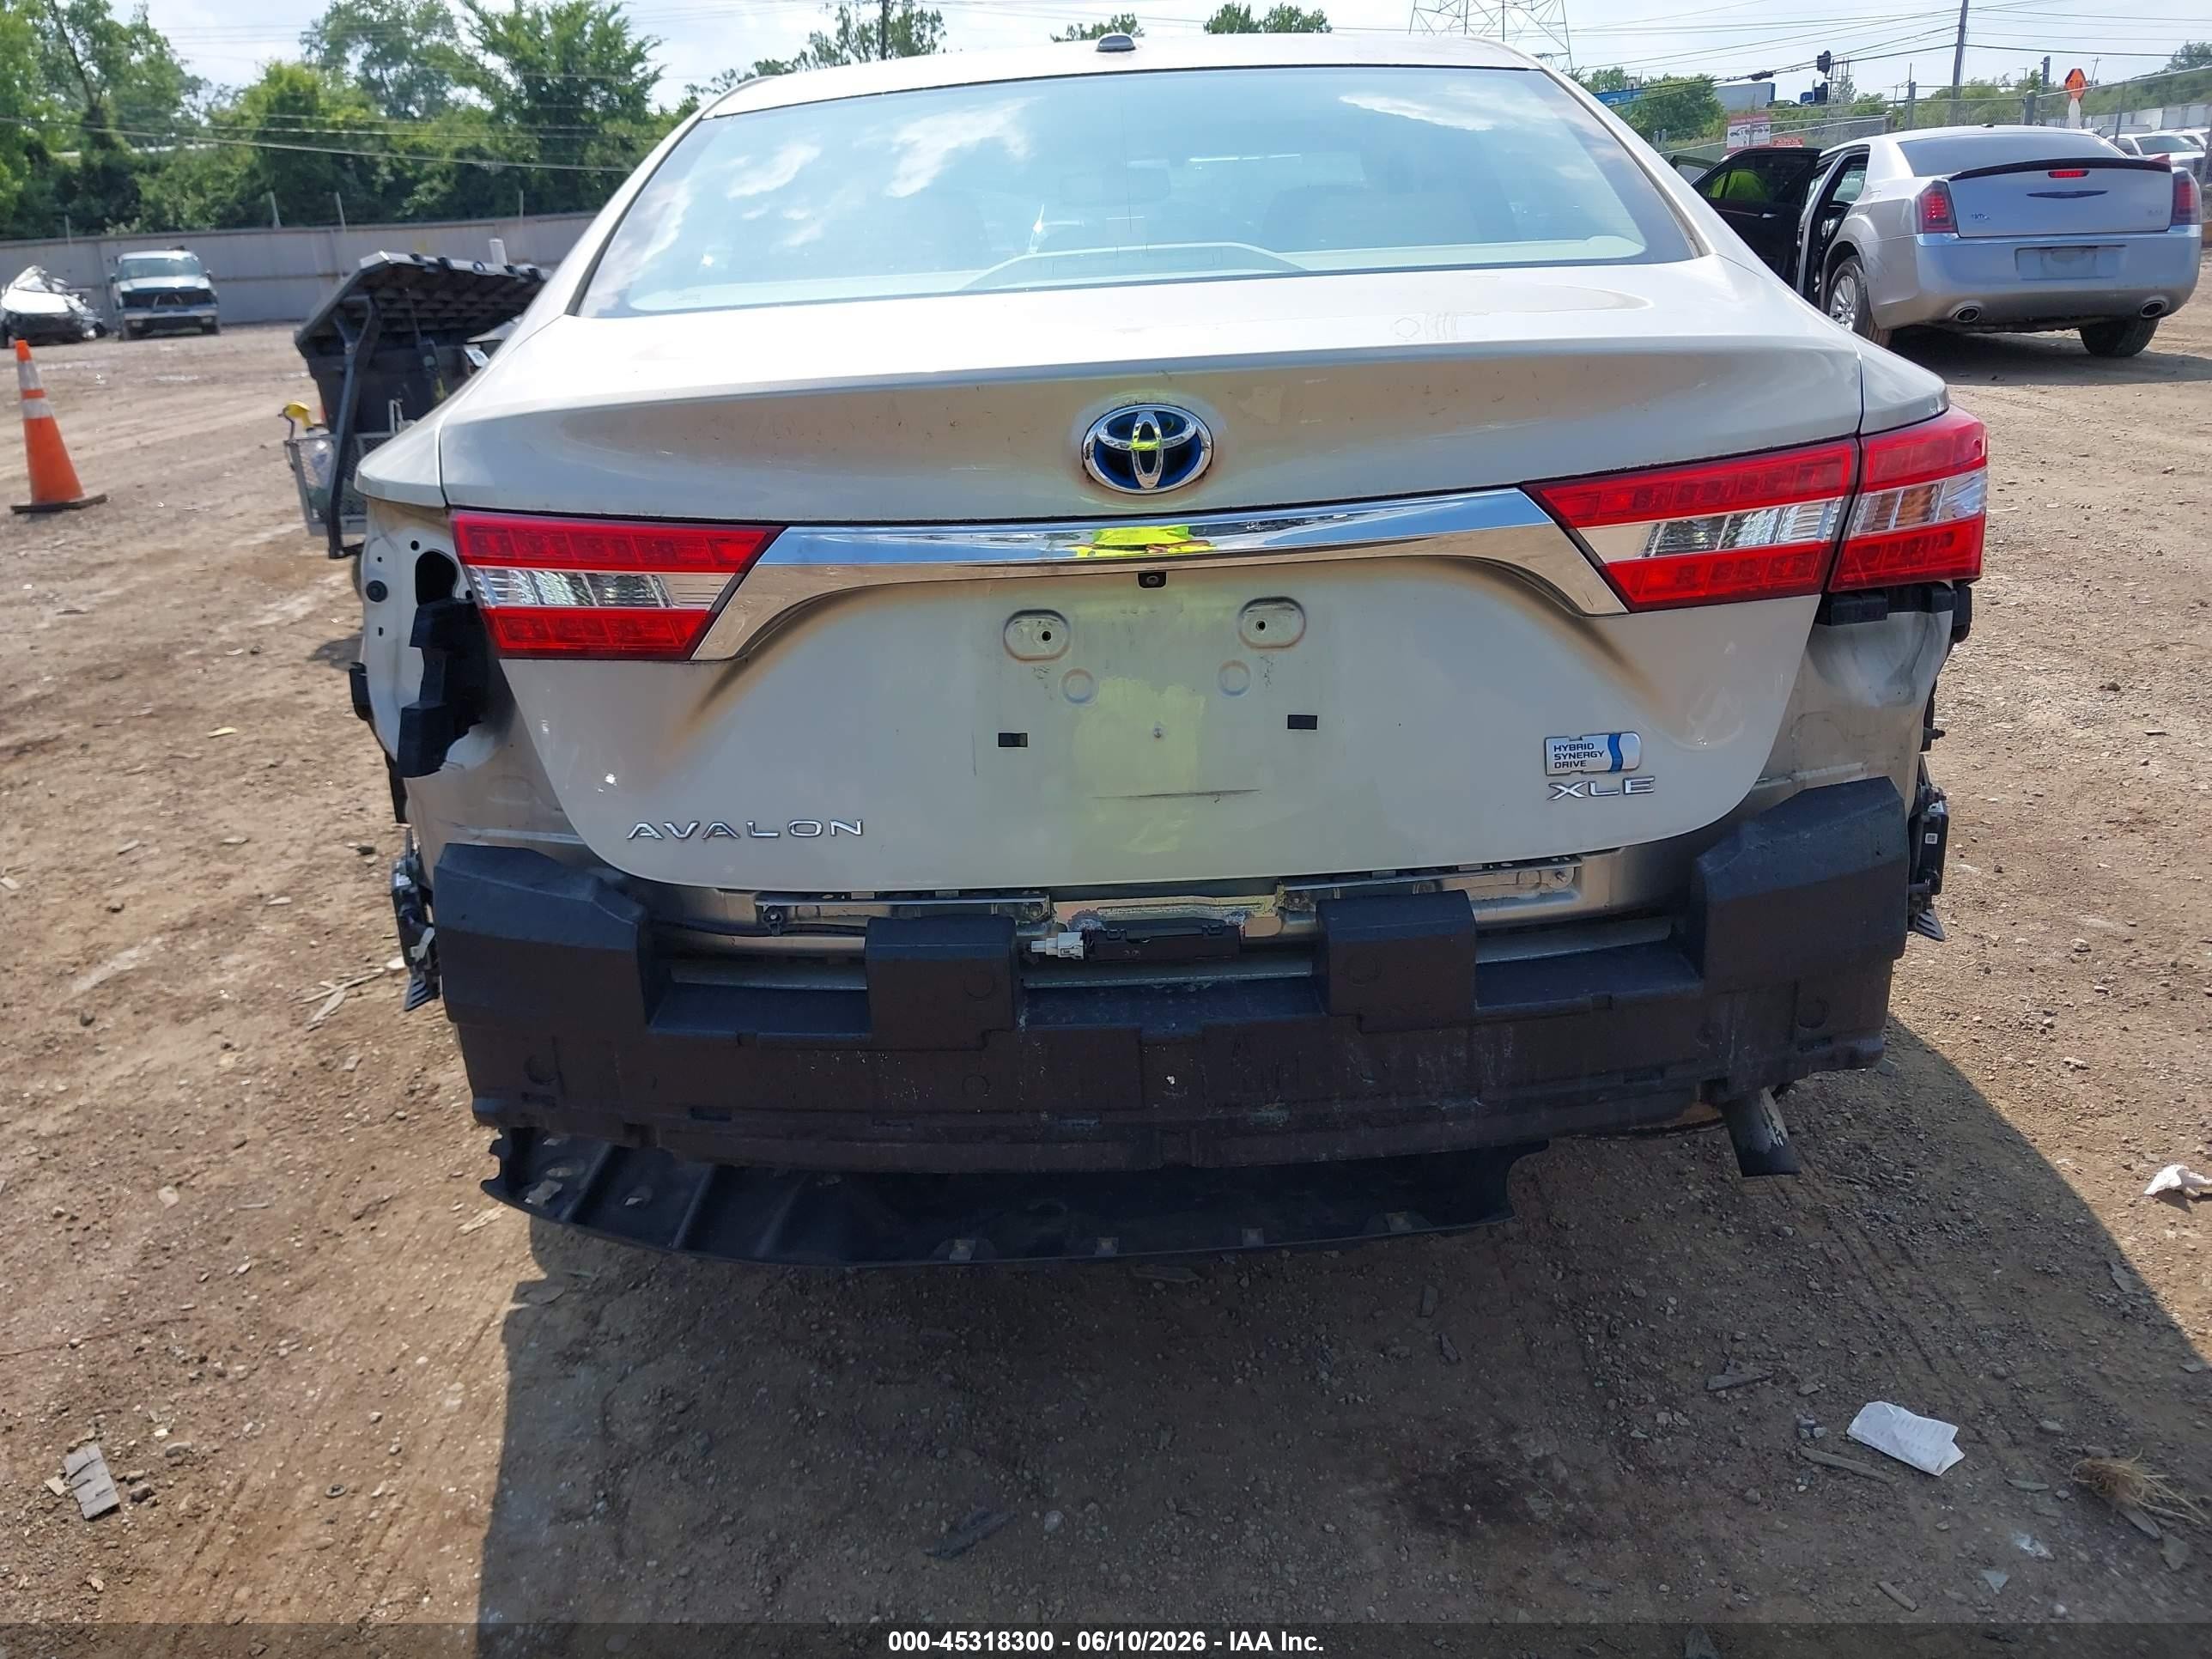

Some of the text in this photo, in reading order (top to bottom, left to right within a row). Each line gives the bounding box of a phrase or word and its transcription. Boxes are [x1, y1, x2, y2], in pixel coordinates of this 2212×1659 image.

[1553, 743, 1595, 752] HYBRID
[1554, 750, 1605, 761] SYNERGY
[1554, 760, 1587, 769] DRIVE
[1547, 776, 1656, 800] XLE
[626, 819, 863, 840] AVALON
